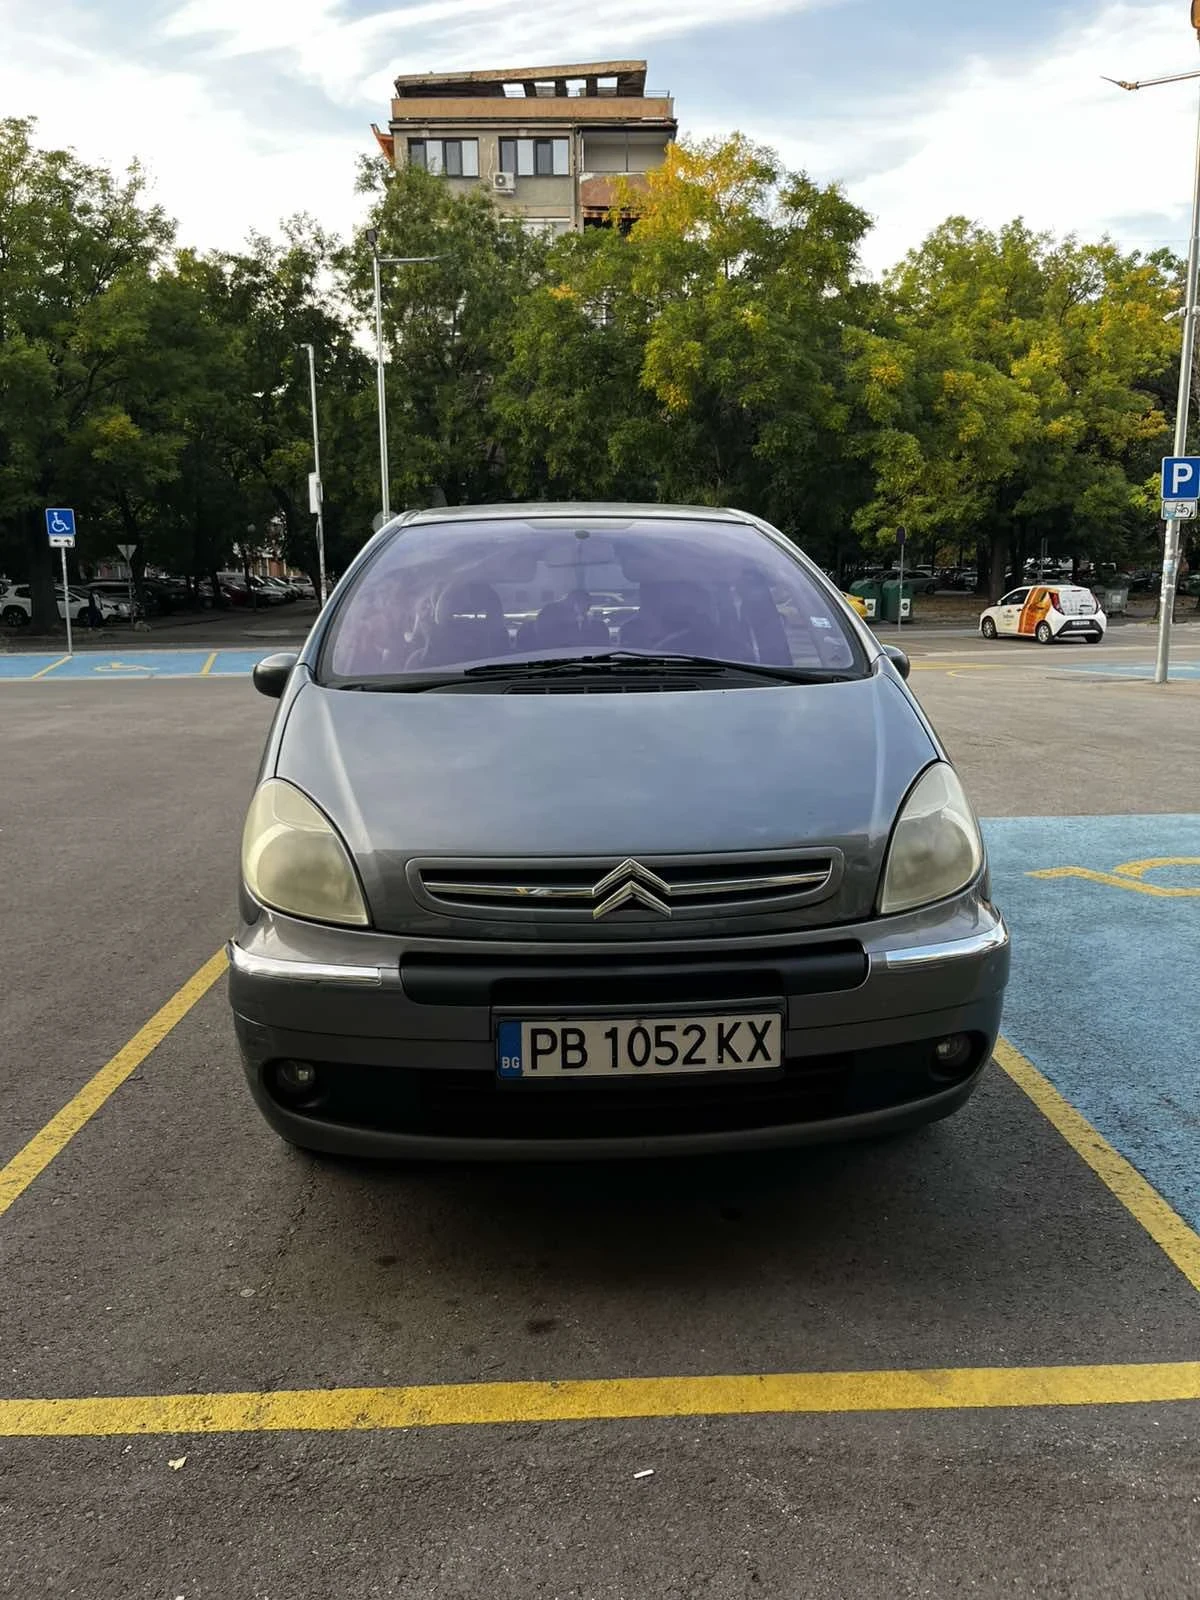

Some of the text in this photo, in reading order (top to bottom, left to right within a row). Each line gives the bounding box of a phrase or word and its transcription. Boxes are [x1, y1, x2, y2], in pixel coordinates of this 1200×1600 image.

[1172, 463, 1193, 494] P
[530, 1020, 772, 1070] PB 1052 KX
[501, 1056, 520, 1069] BG
